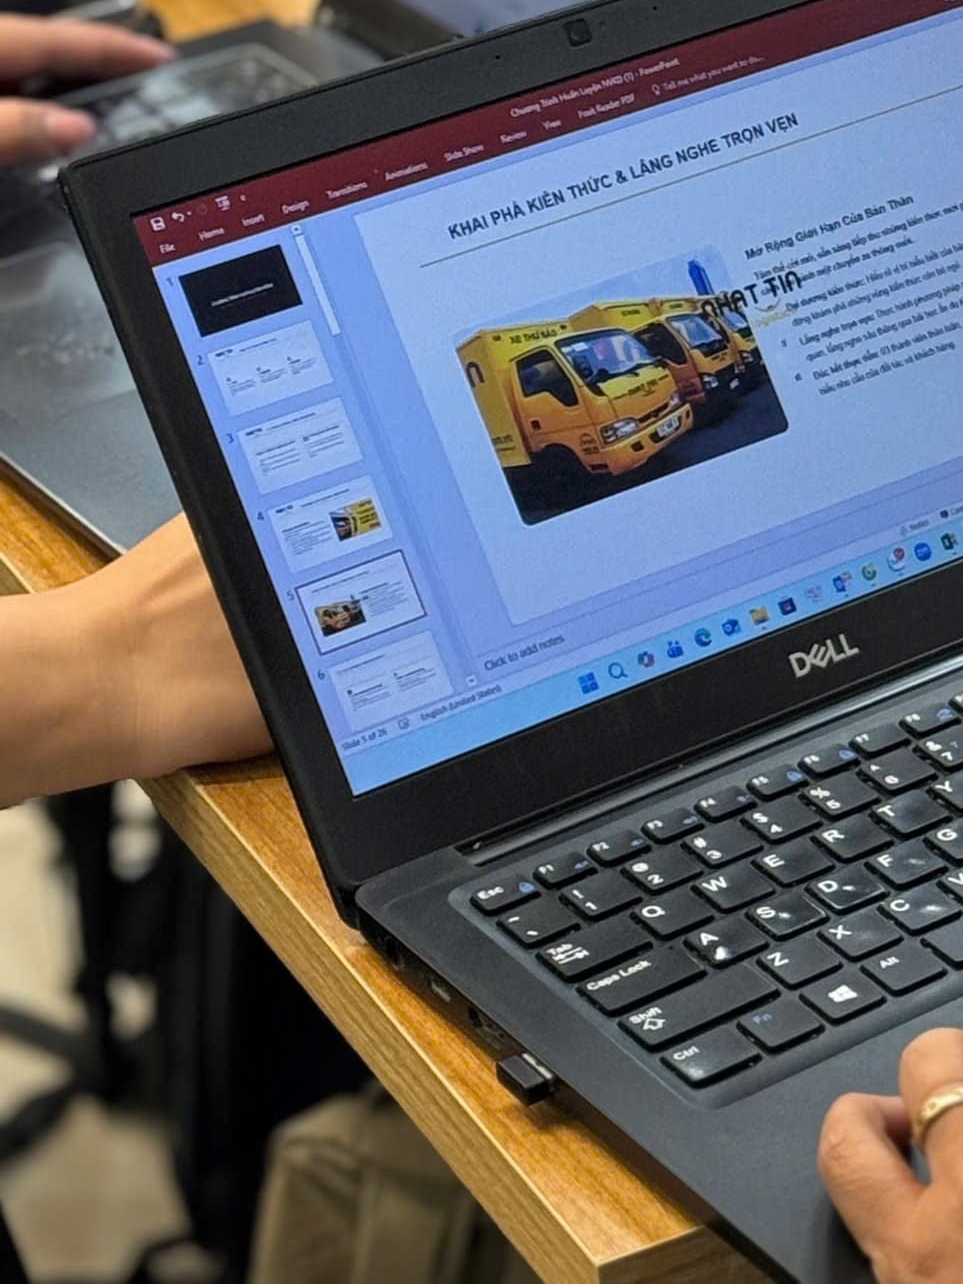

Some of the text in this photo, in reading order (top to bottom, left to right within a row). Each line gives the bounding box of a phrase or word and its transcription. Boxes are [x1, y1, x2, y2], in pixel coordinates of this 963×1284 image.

[446, 214, 489, 240] KHAI
[488, 200, 526, 226] PHÁ
[565, 173, 613, 199] THỨC
[614, 169, 629, 184] &
[674, 138, 721, 164] NGHE
[719, 123, 765, 148] TRỌN
[763, 112, 798, 133] VẸN
[197, 227, 225, 241] Home
[158, 243, 175, 254] File
[483, 633, 566, 671] Click to add notes
[788, 633, 860, 678] DELL
[934, 780, 954, 793] Y
[877, 804, 896, 817] T
[769, 823, 784, 834] 4
[821, 828, 845, 843] R
[936, 828, 958, 842] G
[762, 853, 785, 868] E
[876, 853, 895, 867] F
[647, 874, 665, 885] 2
[702, 875, 728, 892] W
[816, 879, 839, 893] D
[477, 885, 504, 900] Esc
[641, 905, 666, 918] Q
[755, 905, 777, 920] S
[889, 899, 911, 912] C
[699, 931, 720, 946] A
[827, 924, 853, 940] X
[546, 942, 574, 956] Tab
[766, 951, 790, 968] Z
[879, 955, 901, 969] Alt
[585, 960, 652, 991] Caps Lock
[628, 1006, 663, 1025] Shift
[672, 1045, 701, 1062] Ctrl
